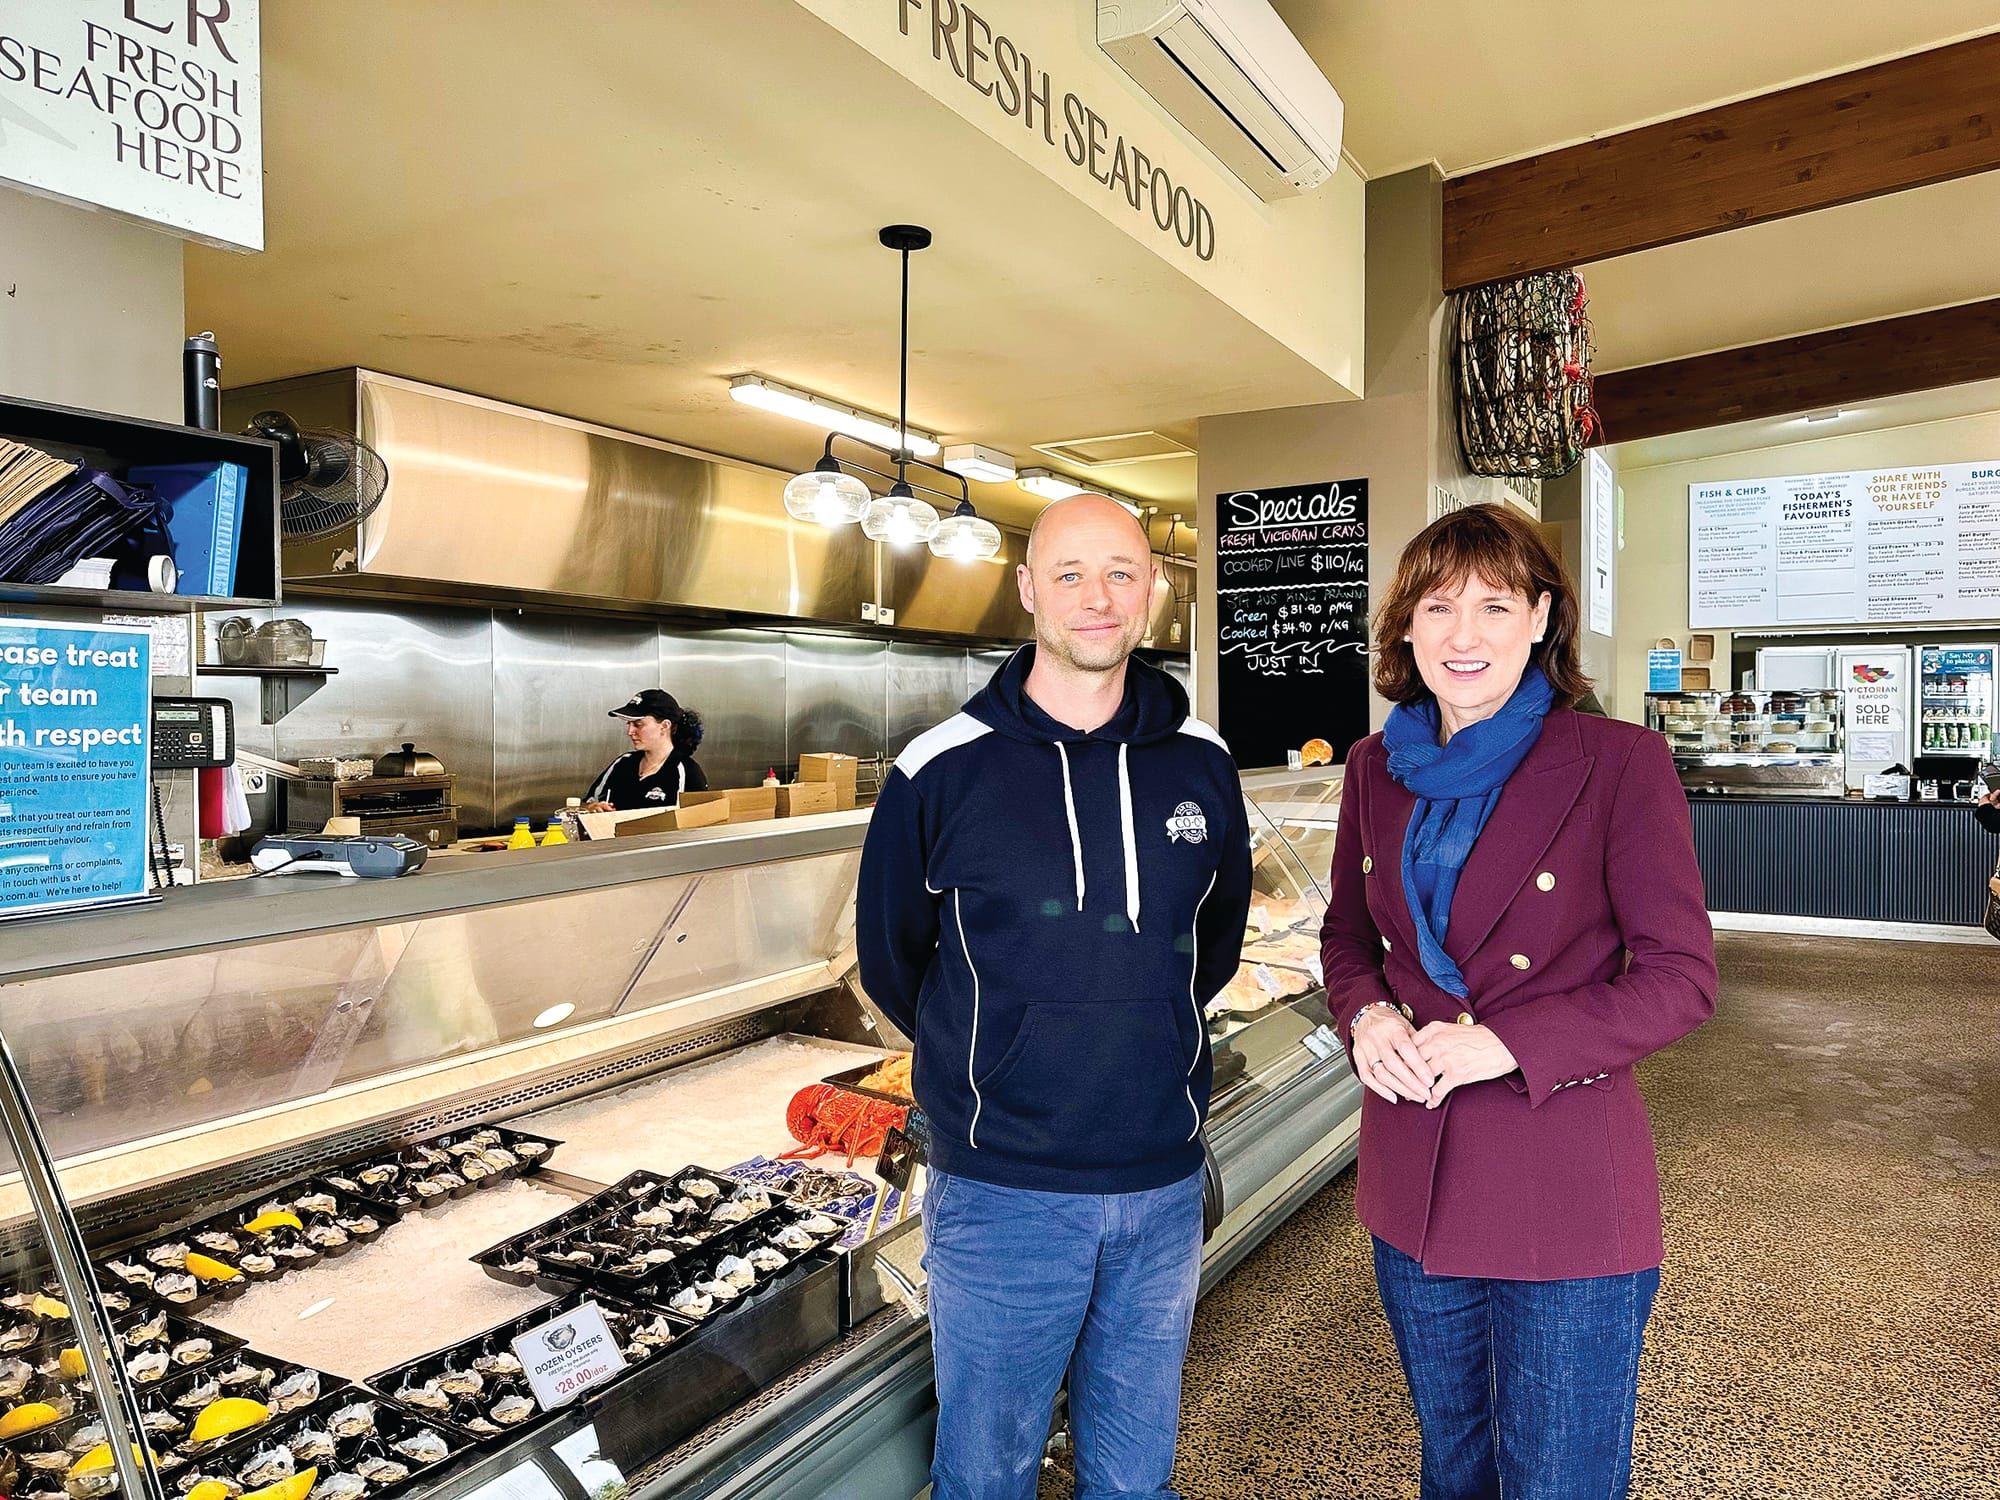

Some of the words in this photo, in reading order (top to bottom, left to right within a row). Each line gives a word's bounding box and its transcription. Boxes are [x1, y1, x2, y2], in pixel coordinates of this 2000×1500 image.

[82, 20, 242, 117] FRESH
[0, 36, 242, 154] SEAFOOD
[112, 122, 242, 199] HERE
[1063, 93, 1215, 262] SEAFOOD
[1872, 474, 1908, 483] SHARE
[1912, 471, 1941, 481] WITH
[1699, 490, 1722, 498] FISH
[1725, 489, 1733, 497] &
[1736, 486, 1767, 496] CHIPS
[1794, 490, 1841, 501] TODAY'S
[1866, 484, 1896, 493] YOUR
[1901, 481, 1947, 491] FRIENDS
[1783, 500, 1853, 511] FISHERMEN'S
[1872, 494, 1888, 503] OR
[1892, 492, 1922, 501] HAVE
[1926, 491, 1941, 499] TO
[1228, 483, 1357, 534] Specials
[1784, 509, 1851, 521] FAVOURITES
[1878, 501, 1935, 512] YOURSELF
[1220, 533, 1256, 548] FRESH
[1261, 526, 1318, 544] VICTORIAN
[1322, 523, 1366, 539] CRAYS
[1223, 558, 1273, 575] COOKED
[1311, 551, 1364, 574] $110/KG
[1257, 593, 1278, 606] AUS
[1286, 590, 1316, 603] KING
[1324, 588, 1367, 601] PRAWNS
[1234, 609, 1268, 623] Green
[1278, 604, 1322, 620] $31.90
[1220, 625, 1268, 640] Cooked
[1272, 619, 1312, 639] $34.90
[66, 643, 139, 669] treat
[1245, 654, 1292, 671] JUST
[1299, 652, 1320, 668] IN
[19, 683, 98, 706] team
[1856, 704, 1890, 714] SOLD
[1856, 714, 1889, 725] HERE
[35, 723, 142, 752] respect
[4, 762, 20, 770] Our
[22, 762, 44, 770] team
[47, 761, 54, 769] is
[56, 760, 86, 769] excited
[89, 760, 97, 768] to
[99, 759, 118, 767] have
[120, 760, 134, 768] you
[14, 774, 30, 783] and
[32, 774, 58, 782] wants
[71, 773, 99, 781] ensure
[101, 773, 116, 781] you
[19, 813, 35, 822] that
[38, 813, 53, 822] you
[56, 811, 75, 820] treat
[93, 809, 113, 817] team
[115, 808, 130, 816] and
[13, 824, 64, 836] respectfully
[66, 823, 82, 831] and
[84, 821, 110, 830] refrain
[112, 820, 131, 828] from
[17, 839, 47, 848] violent
[49, 836, 92, 846] behaviour.
[5, 867, 21, 876] any
[23, 864, 63, 873] concerns
[76, 858, 122, 868] complaints,
[3, 880, 11, 888] in
[13, 877, 38, 887] touch
[40, 875, 58, 884] with
[73, 873, 81, 881] at
[46, 888, 70, 896] We're
[72, 885, 90, 894] here
[92, 884, 100, 892] to
[102, 881, 122, 891] help!
[535, 1354, 565, 1375] DOZEN
[565, 1334, 603, 1359] OYSTERS
[554, 1364, 609, 1394] $28.00/doz
